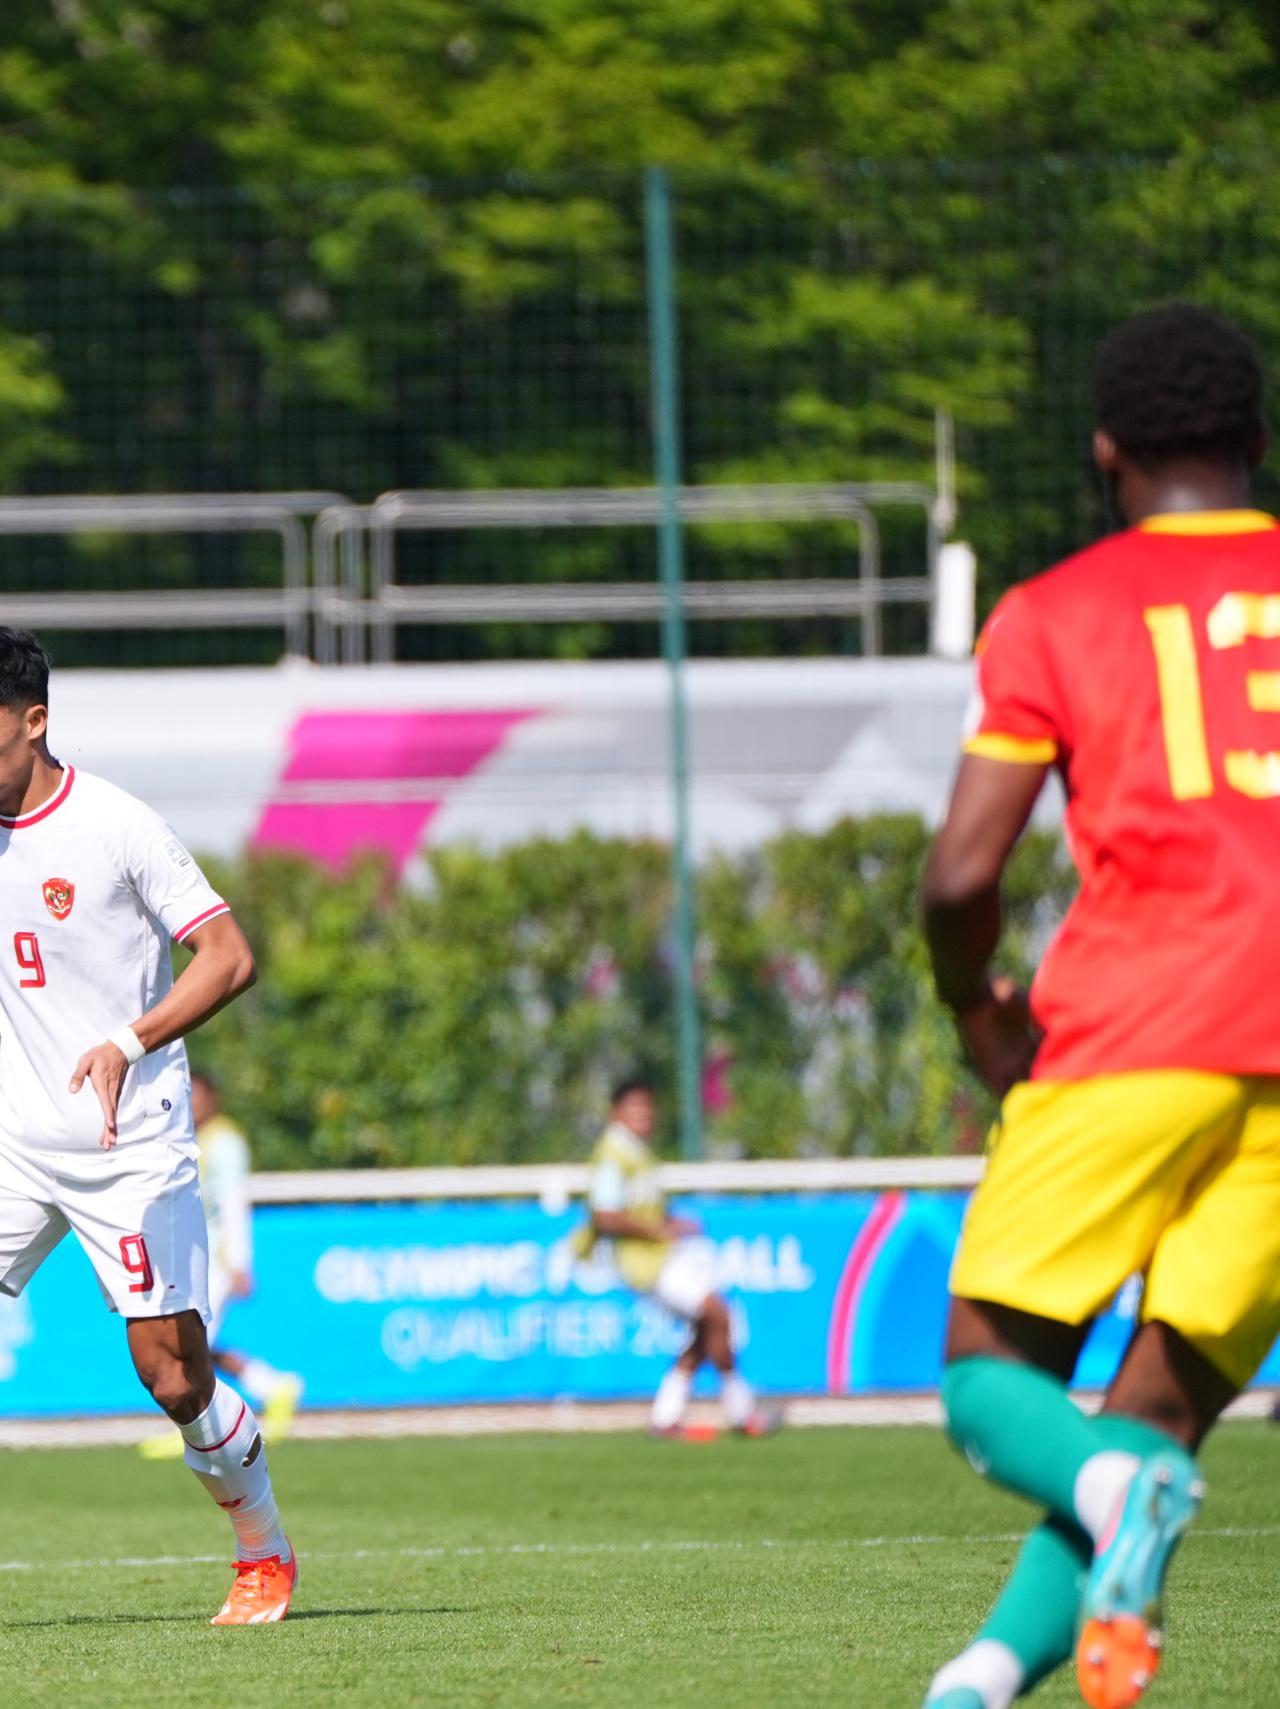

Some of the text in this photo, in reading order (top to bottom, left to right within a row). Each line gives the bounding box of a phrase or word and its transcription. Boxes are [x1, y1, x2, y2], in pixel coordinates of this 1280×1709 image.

[1144, 592, 1280, 801] 13
[13, 931, 46, 988] 9
[118, 1233, 155, 1293] 9
[315, 1242, 544, 1303] OLYMPIC
[381, 1300, 624, 1372] QUALIFIER
